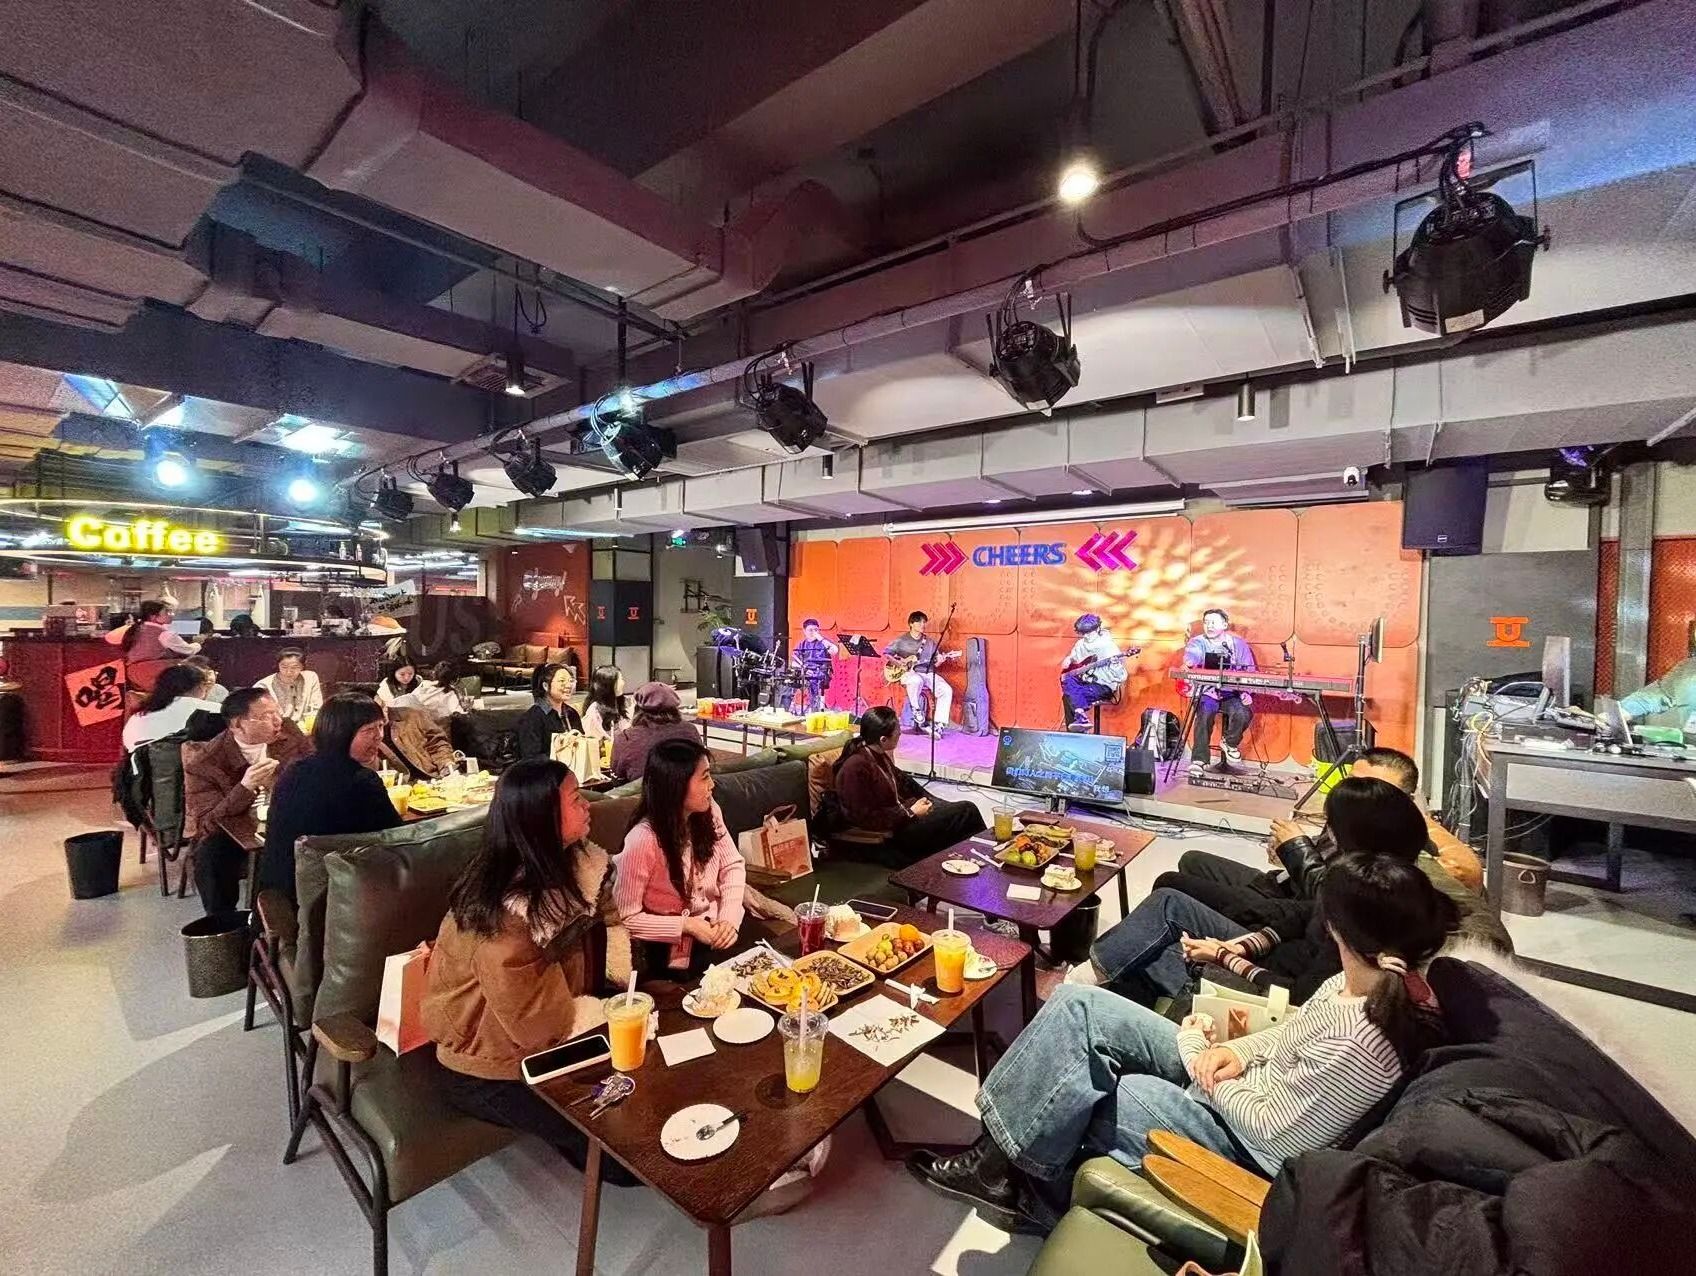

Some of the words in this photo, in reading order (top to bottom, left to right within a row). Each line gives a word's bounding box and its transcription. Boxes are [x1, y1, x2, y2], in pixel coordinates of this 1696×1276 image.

[68, 515, 219, 553] Coffee
[972, 542, 1067, 567] CHEERS
[745, 608, 758, 625] U
[1486, 616, 1530, 647] U
